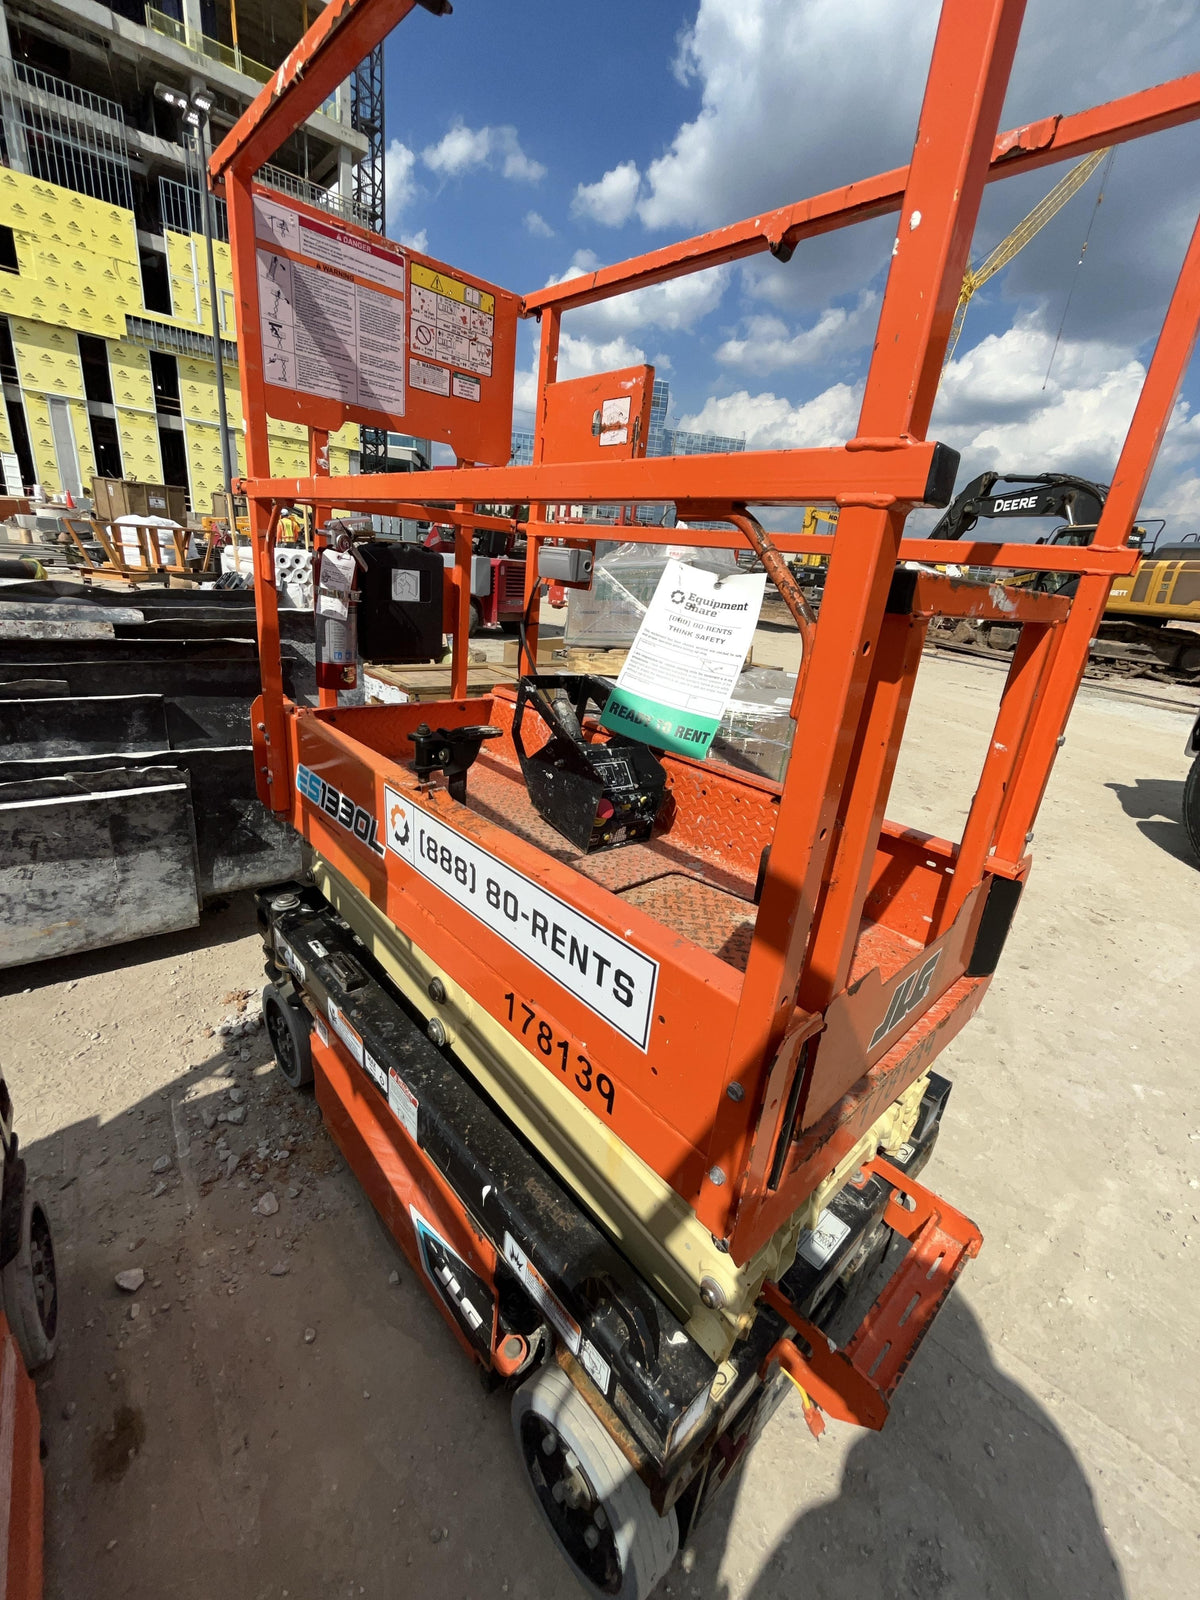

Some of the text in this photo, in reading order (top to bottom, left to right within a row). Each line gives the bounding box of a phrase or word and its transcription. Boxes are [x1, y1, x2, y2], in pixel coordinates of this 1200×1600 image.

[343, 235, 372, 253] DANGER
[323, 263, 355, 282] WARNING
[421, 362, 444, 373] WARNING
[993, 496, 1038, 513] DEERE
[684, 602, 718, 617] Share
[688, 592, 749, 611] Equipment
[669, 625, 726, 645] THINK SAFETY
[609, 701, 711, 744] READY TO RENT
[297, 763, 386, 859] ES1330L
[419, 829, 635, 1008] (888) 80-RENTS
[867, 947, 943, 1053] JLG
[504, 992, 615, 1115] 178139
